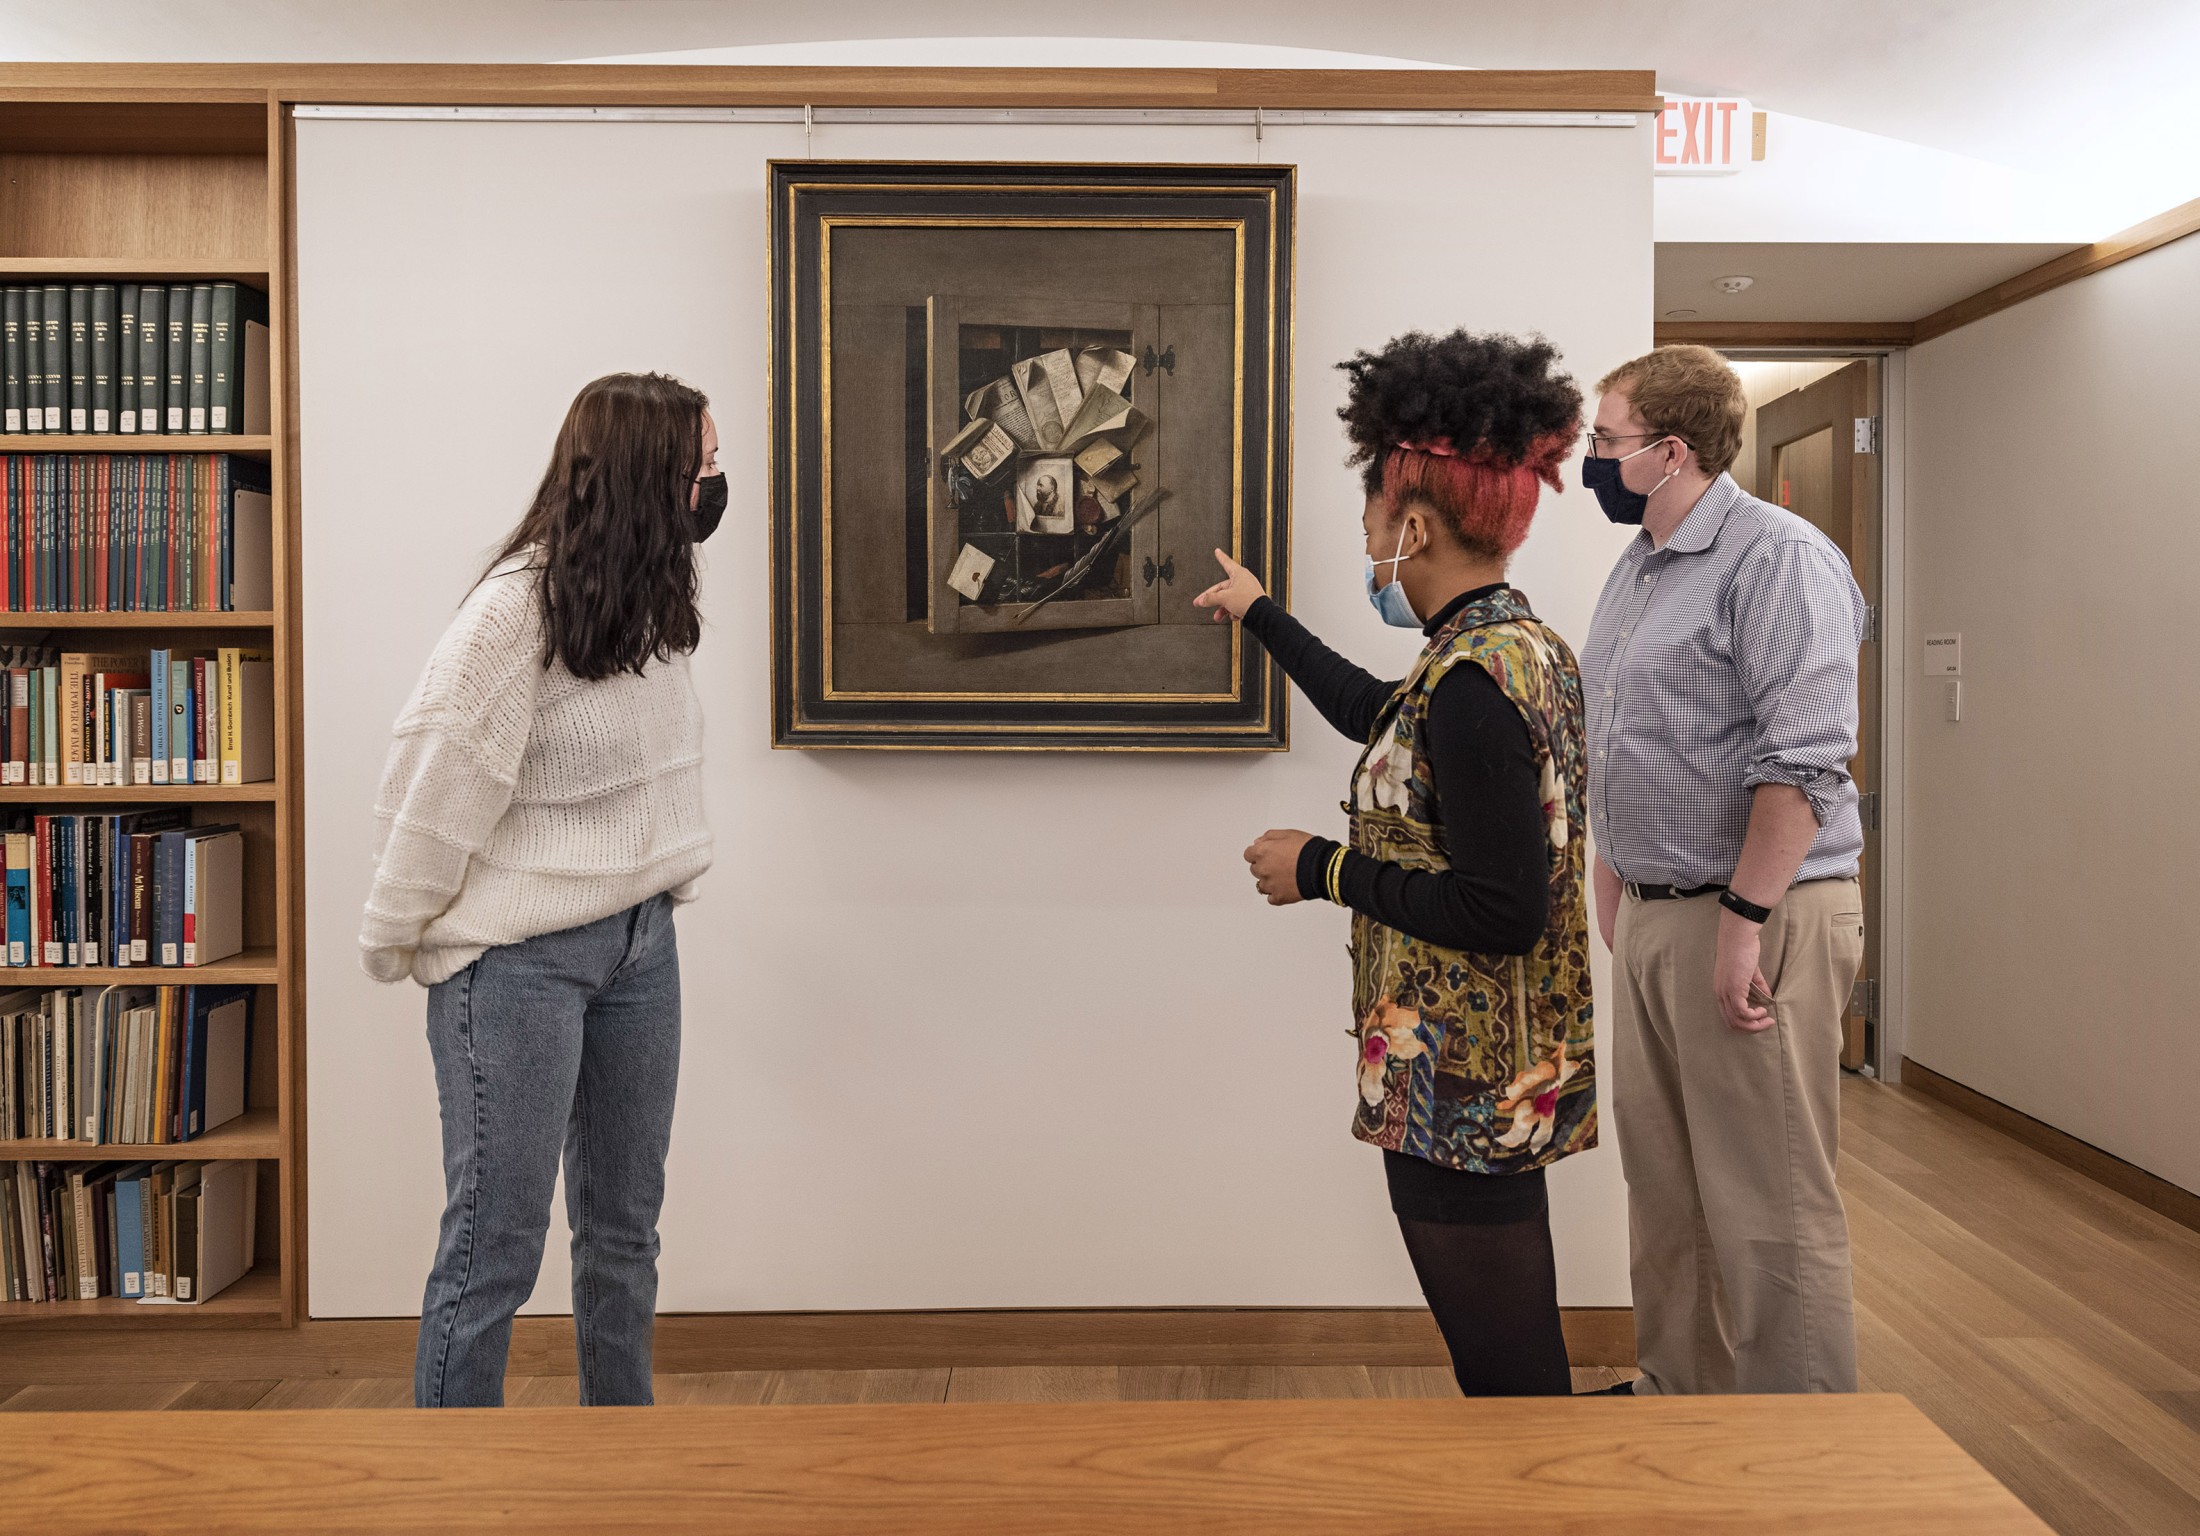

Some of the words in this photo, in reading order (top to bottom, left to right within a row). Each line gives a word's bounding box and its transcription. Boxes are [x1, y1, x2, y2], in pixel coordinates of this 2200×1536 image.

[1656, 102, 1738, 164] EXIT
[70, 672, 78, 689] THE
[70, 692, 79, 722] POWER
[71, 724, 79, 734] OF
[135, 874, 144, 883] Art
[135, 885, 144, 909] Museum
